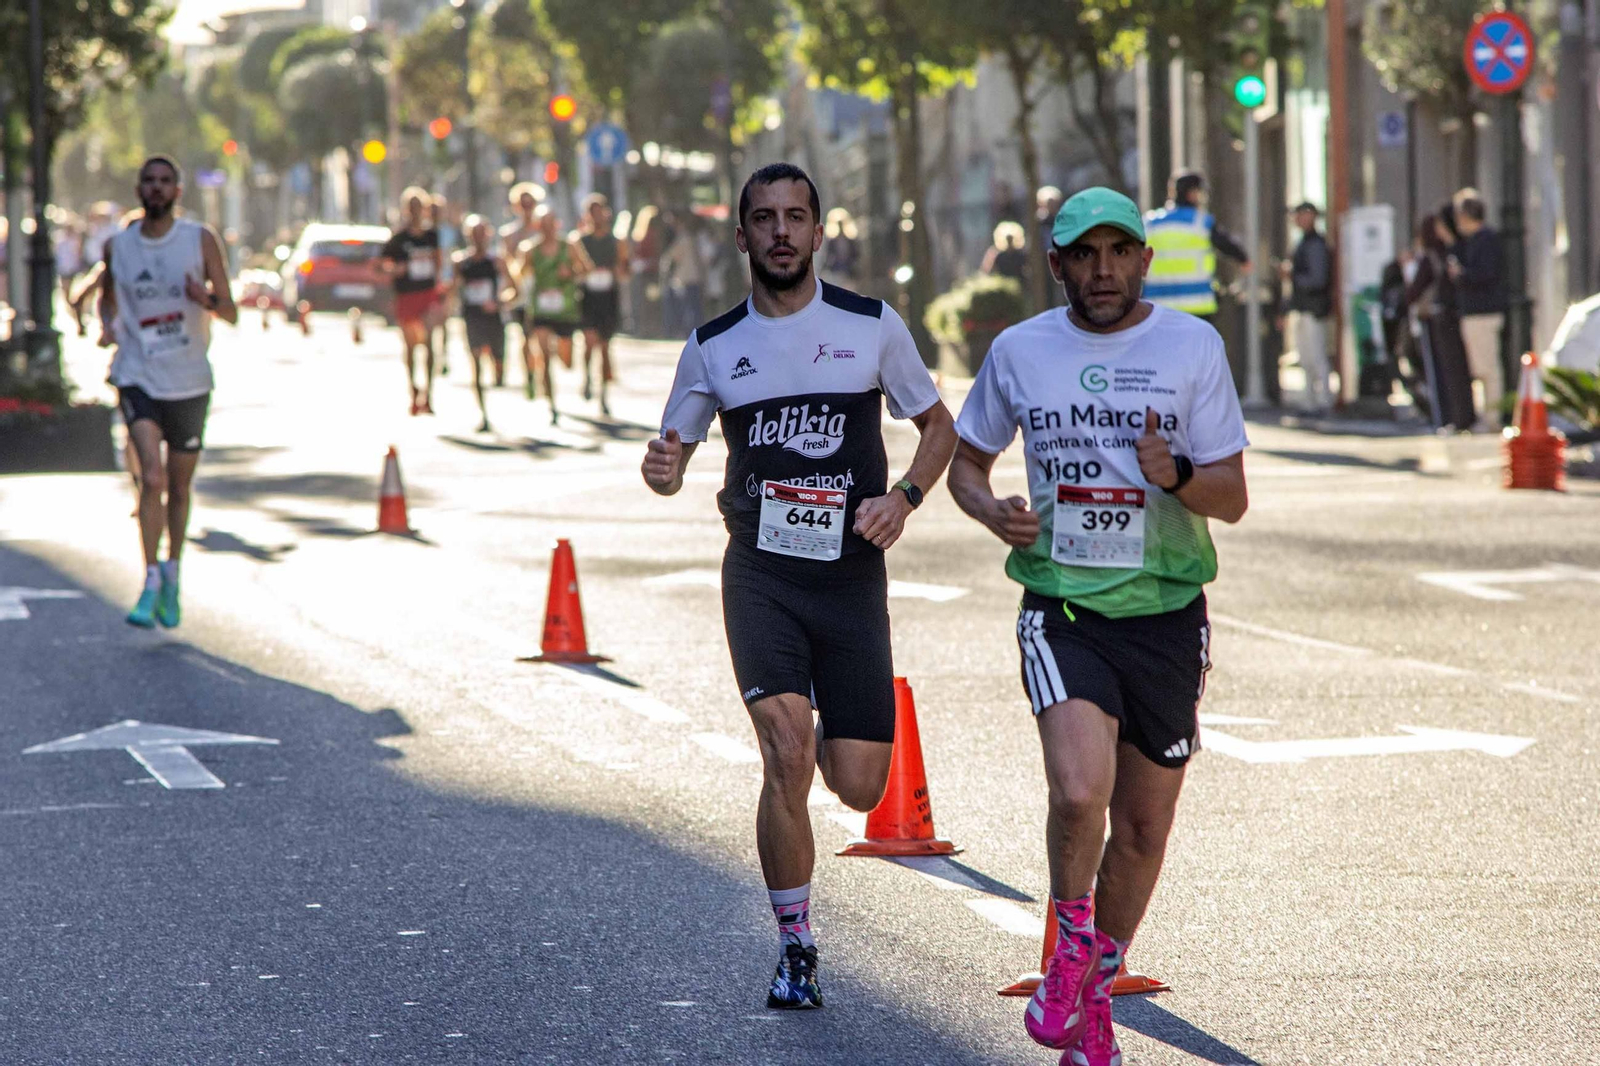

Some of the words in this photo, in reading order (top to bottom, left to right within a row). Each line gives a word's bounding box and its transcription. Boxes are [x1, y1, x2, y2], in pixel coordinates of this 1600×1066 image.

[748, 404, 846, 447] delikia
[1029, 407, 1061, 431] En
[802, 437, 830, 451] fresh
[1034, 435, 1080, 452] contra
[1084, 435, 1098, 448] el
[1038, 457, 1102, 484] Vigo
[786, 507, 832, 530] 644
[1081, 510, 1131, 532] 399
